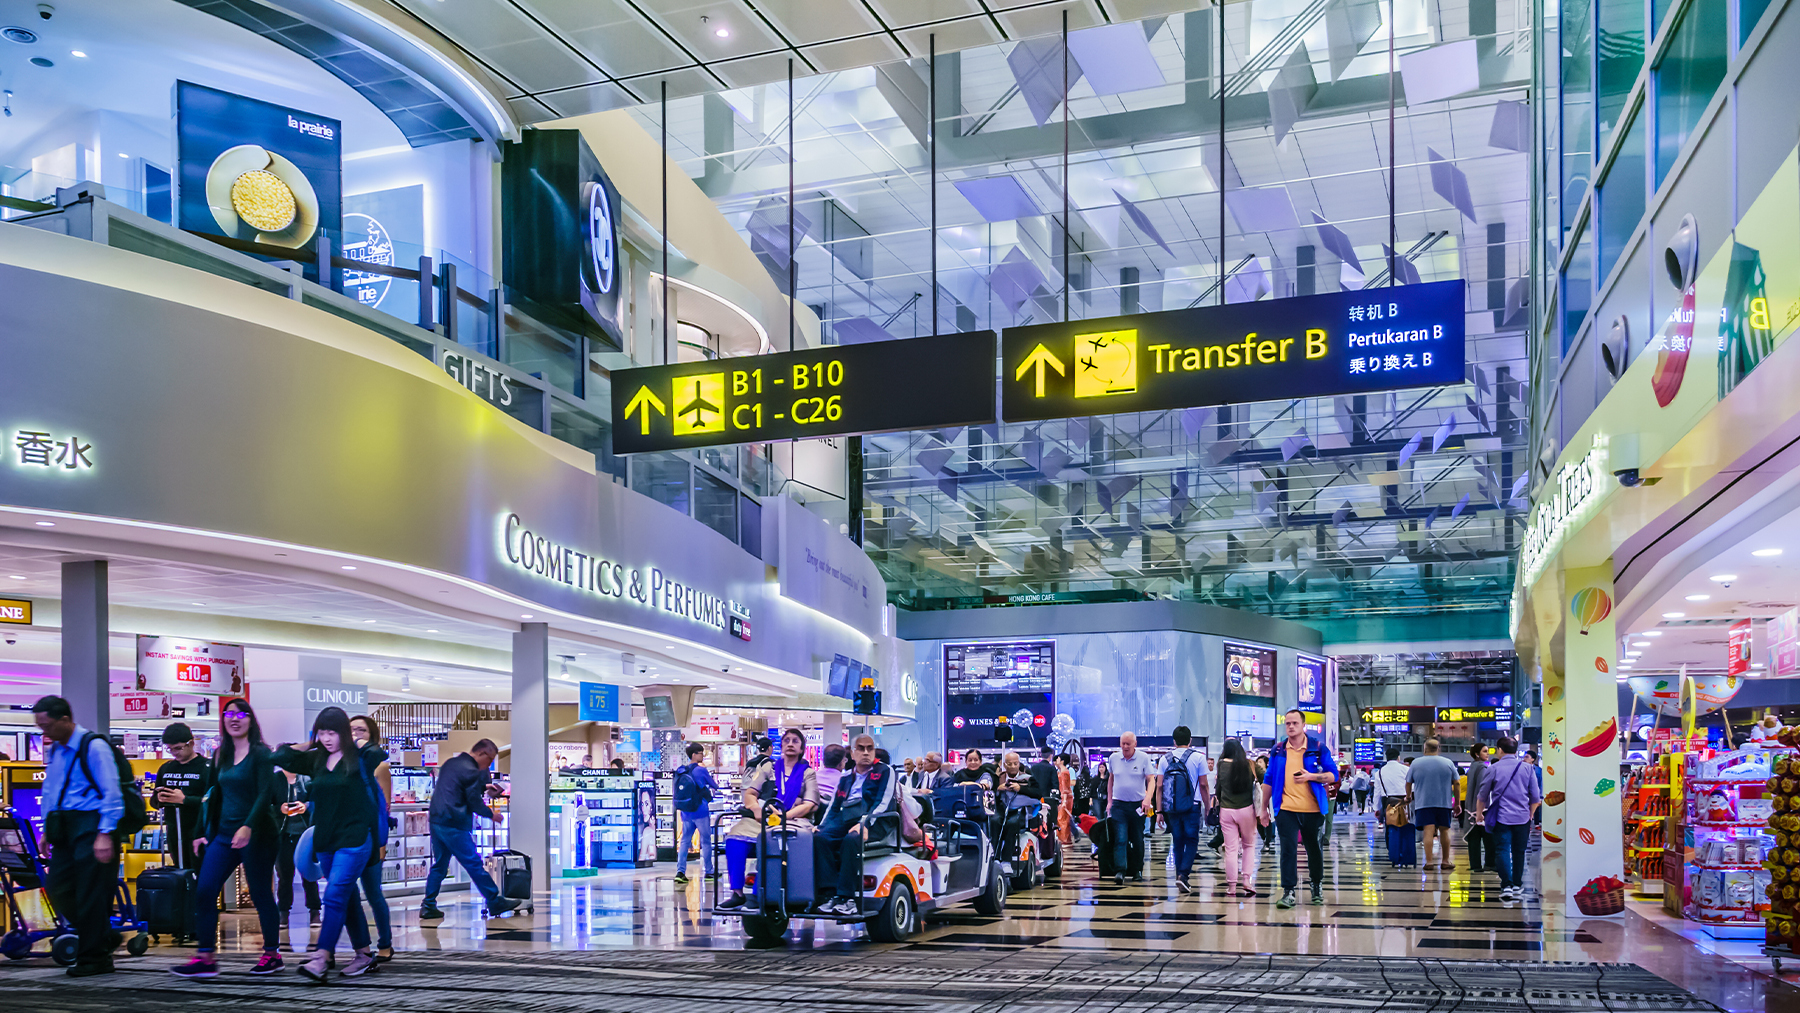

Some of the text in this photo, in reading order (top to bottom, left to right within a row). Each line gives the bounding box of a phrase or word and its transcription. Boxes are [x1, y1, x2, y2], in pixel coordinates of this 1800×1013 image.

[288, 115, 299, 129] la
[299, 121, 334, 137] prairie
[1349, 303, 1399, 322] 转机 B
[1348, 324, 1443, 348] Pertukaran B
[1147, 328, 1328, 374] Transfer B
[1349, 351, 1433, 374] 乗り換え B
[443, 350, 512, 406] GIFTS
[732, 368, 762, 396] B1
[793, 360, 844, 390] B10
[732, 402, 762, 430] C1
[791, 395, 843, 425] C26
[16, 430, 93, 469] 香水
[629, 569, 647, 604] &
[1008, 593, 1056, 603] HONG KONG CAFE
[0, 606, 25, 619] NE
[145, 651, 169, 659] INSTANT
[170, 653, 193, 662] SAVINGS
[208, 658, 236, 666] PURCHASE
[306, 687, 365, 706] CLINIQUE
[968, 718, 993, 726] WINES
